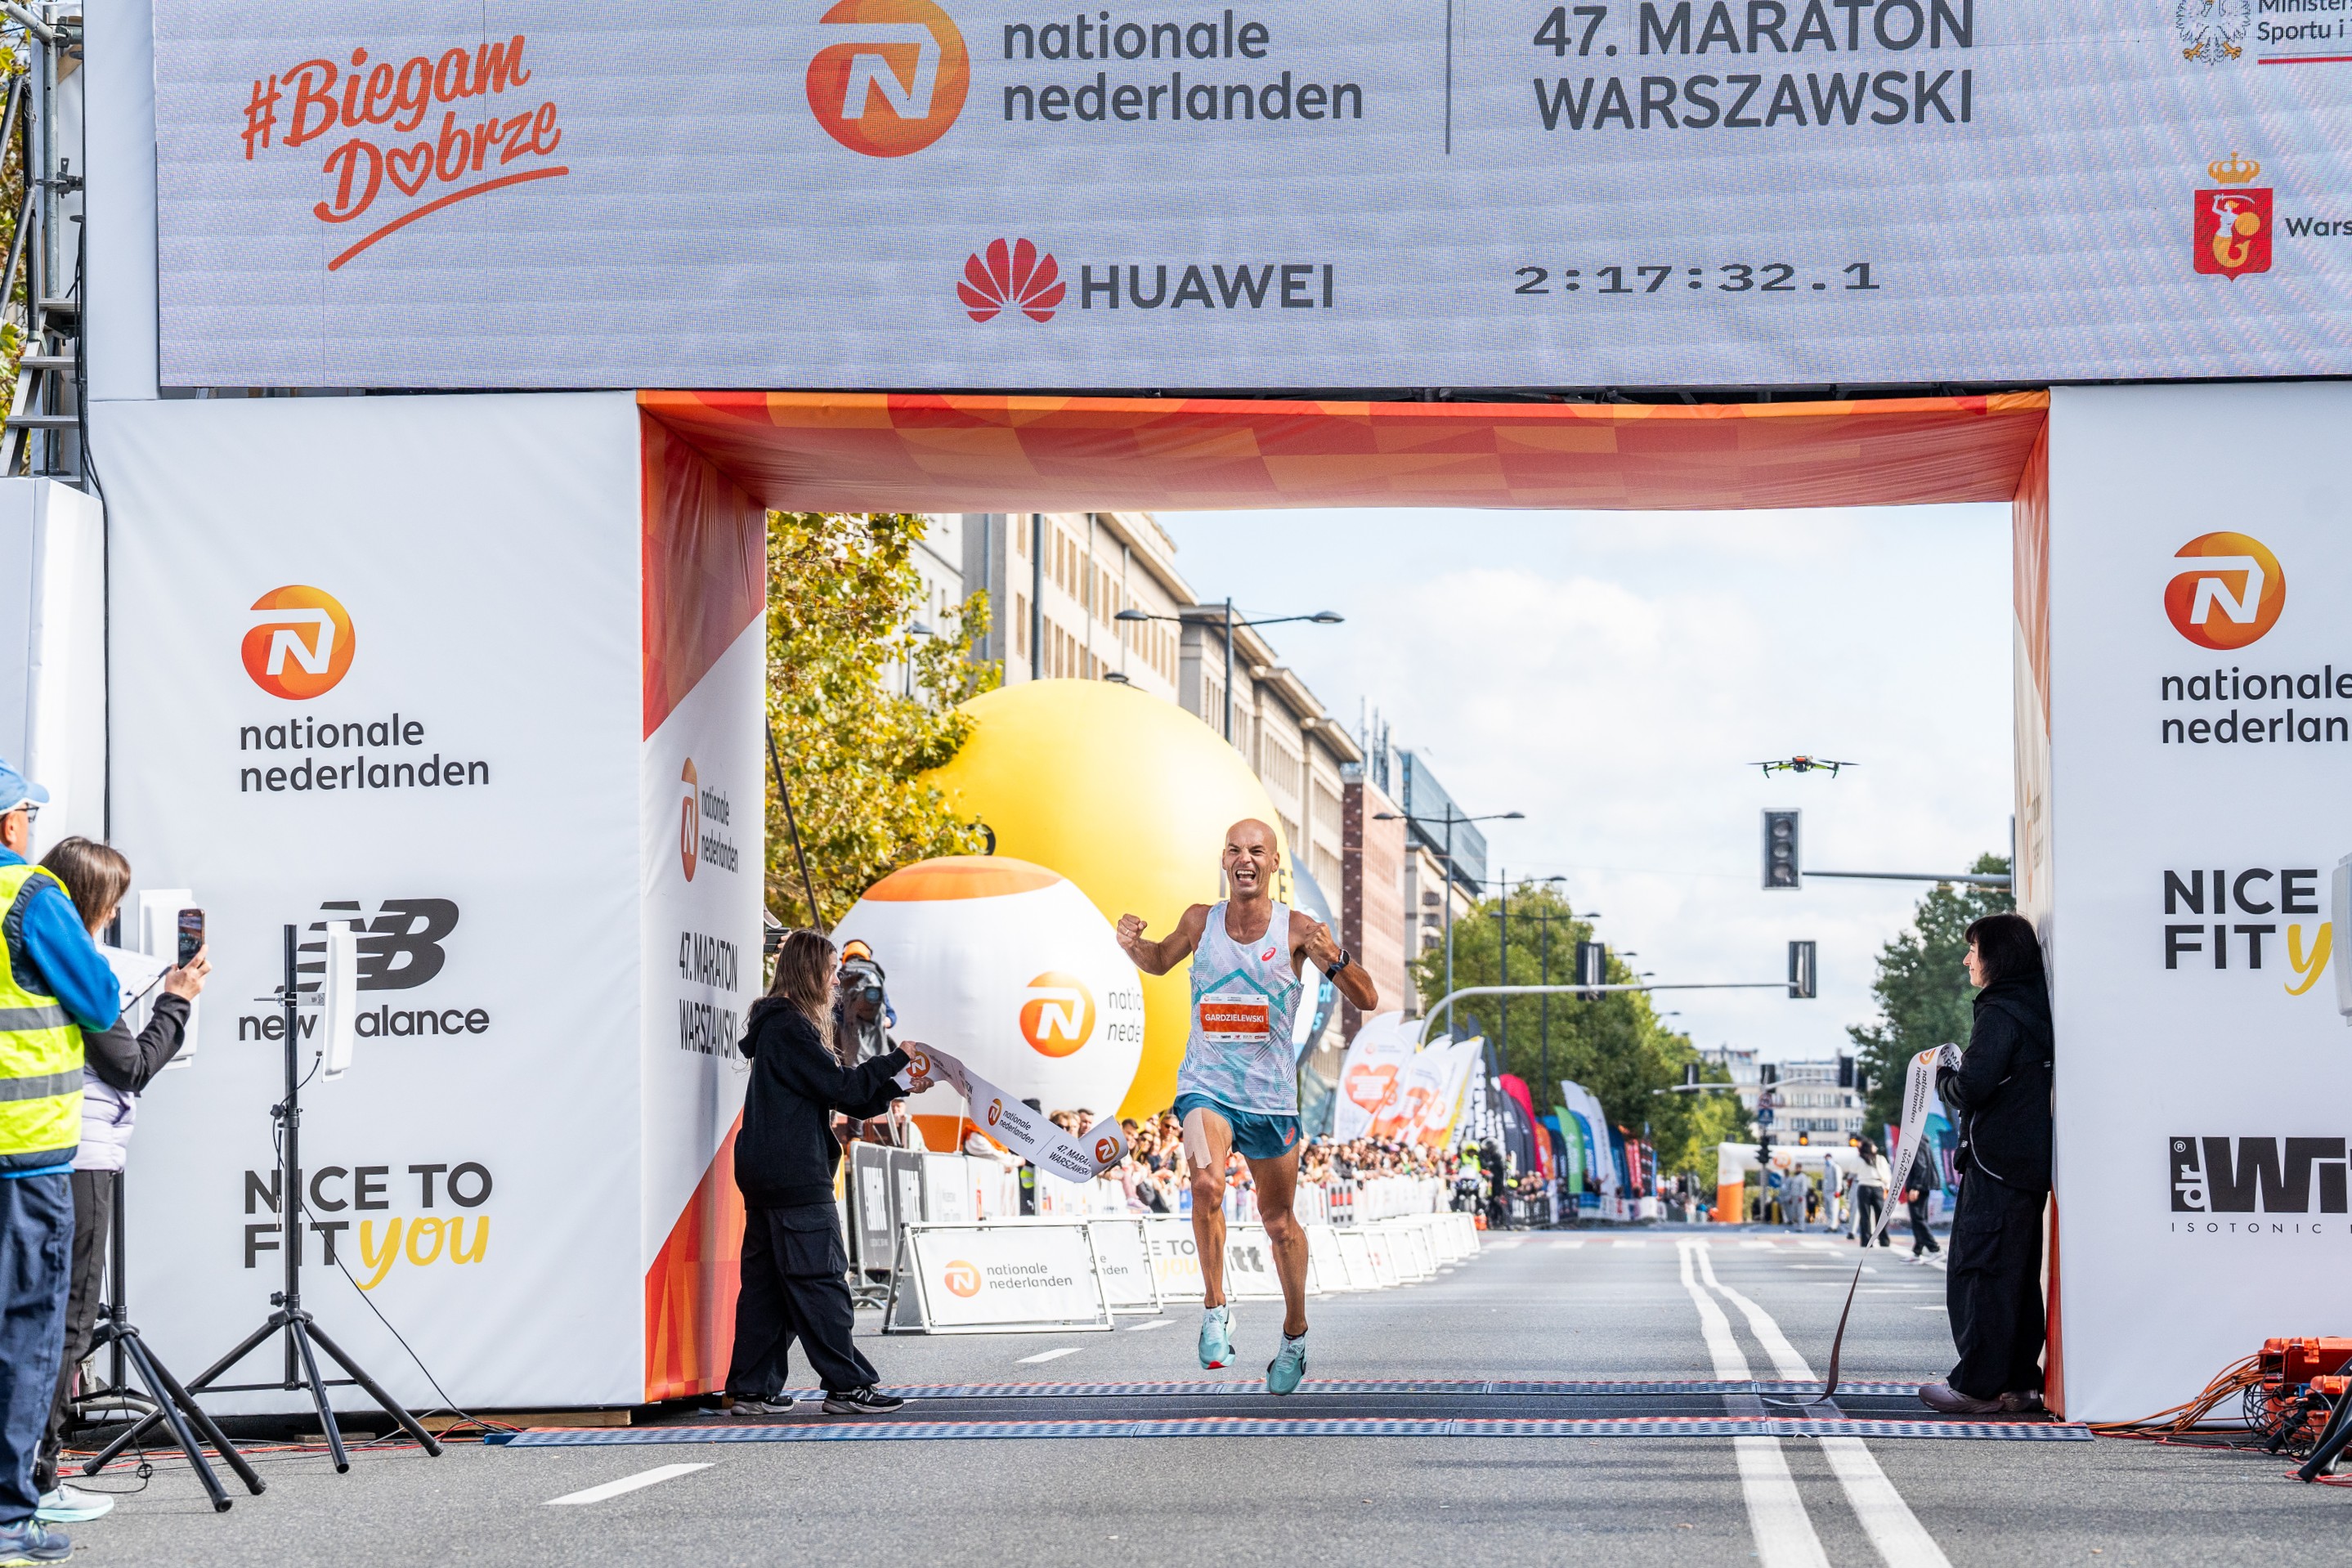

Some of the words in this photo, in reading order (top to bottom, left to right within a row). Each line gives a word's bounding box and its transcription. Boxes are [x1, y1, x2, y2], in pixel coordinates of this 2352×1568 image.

[1004, 8, 1270, 60] nationale
[1534, 6, 1618, 58] 47.
[1638, 0, 1974, 55] MARATON
[2257, 21, 2331, 45] Sportu
[2339, 19, 2345, 38] i
[241, 34, 531, 160] #Biegam
[1004, 71, 1364, 122] nederlanden
[1534, 69, 1973, 131] WARSZAWSKI
[1080, 263, 1334, 310] HUAWEI
[1515, 262, 1880, 294] 2:17:32.1
[2162, 665, 2352, 702] nationale
[240, 713, 425, 750] nationale
[240, 753, 490, 792] nederlanden
[701, 785, 730, 827] nationale
[701, 831, 739, 874] nederlanden
[2164, 867, 2318, 915] NICE
[679, 931, 692, 980] 47.
[694, 932, 738, 993] MARATON
[354, 1005, 490, 1037] alance
[679, 998, 738, 1060] WARSZAWSKI
[1204, 1013, 1265, 1023] GARDZIELEWSKI
[1910, 1067, 1921, 1124] nederlanden
[1918, 1069, 1928, 1113] nationale
[999, 1119, 1035, 1145] nederlanden
[1003, 1110, 1032, 1131] nationale
[1056, 1145, 1068, 1154] 47.
[408, 1162, 493, 1208] TO
[2171, 1222, 2322, 1234] ISOTONIC
[356, 1215, 490, 1291] you
[987, 1261, 1048, 1276] nationale
[989, 1275, 1073, 1290] nederlanden
